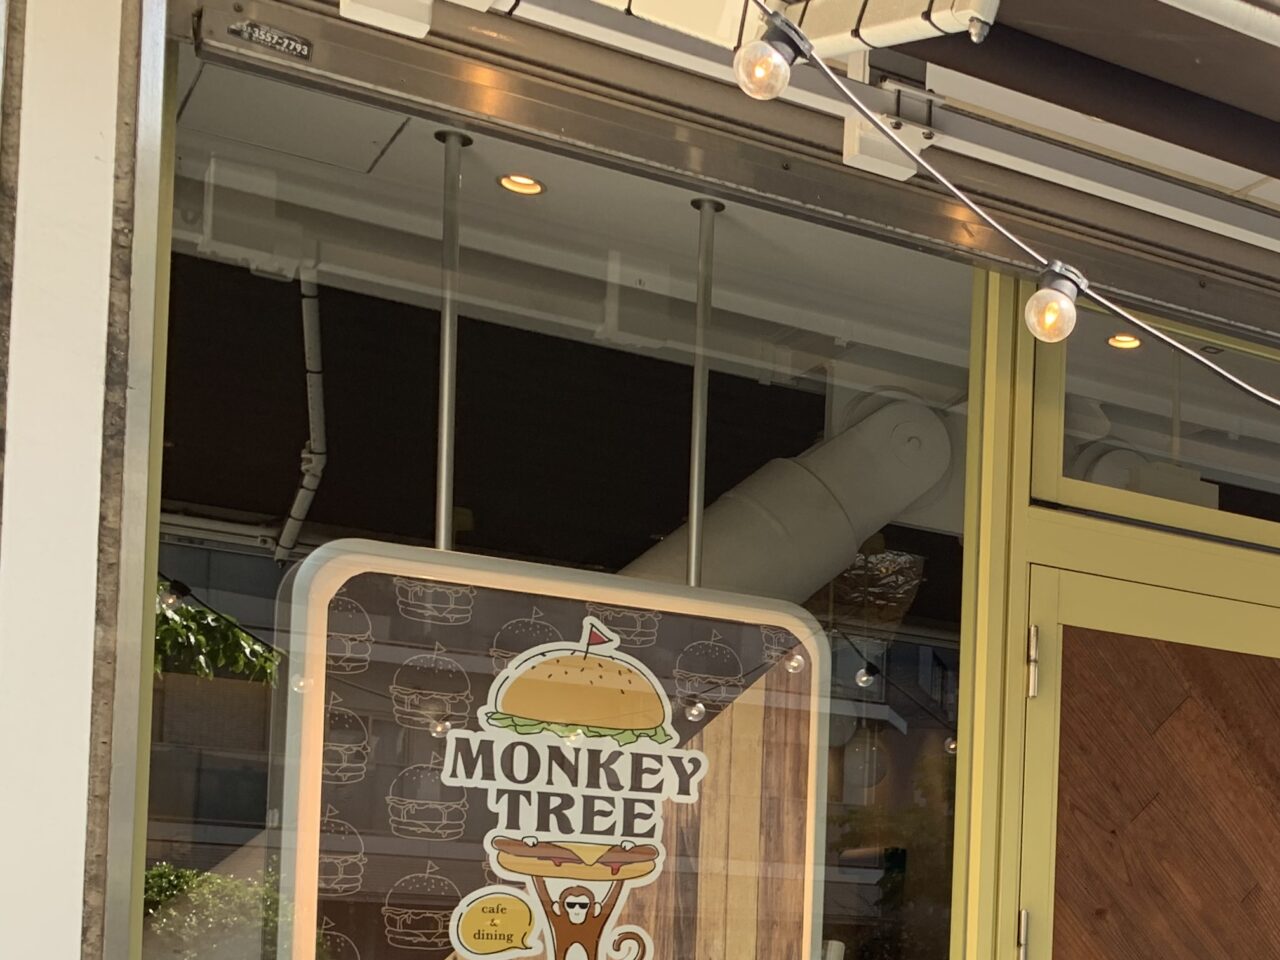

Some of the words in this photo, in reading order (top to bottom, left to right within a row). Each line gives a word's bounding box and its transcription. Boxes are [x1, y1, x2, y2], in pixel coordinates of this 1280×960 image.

[448, 736, 703, 798] MONKEY
[495, 787, 657, 839] TREE
[480, 902, 508, 917] cafe
[490, 918, 499, 930] &
[472, 929, 515, 944] dining
